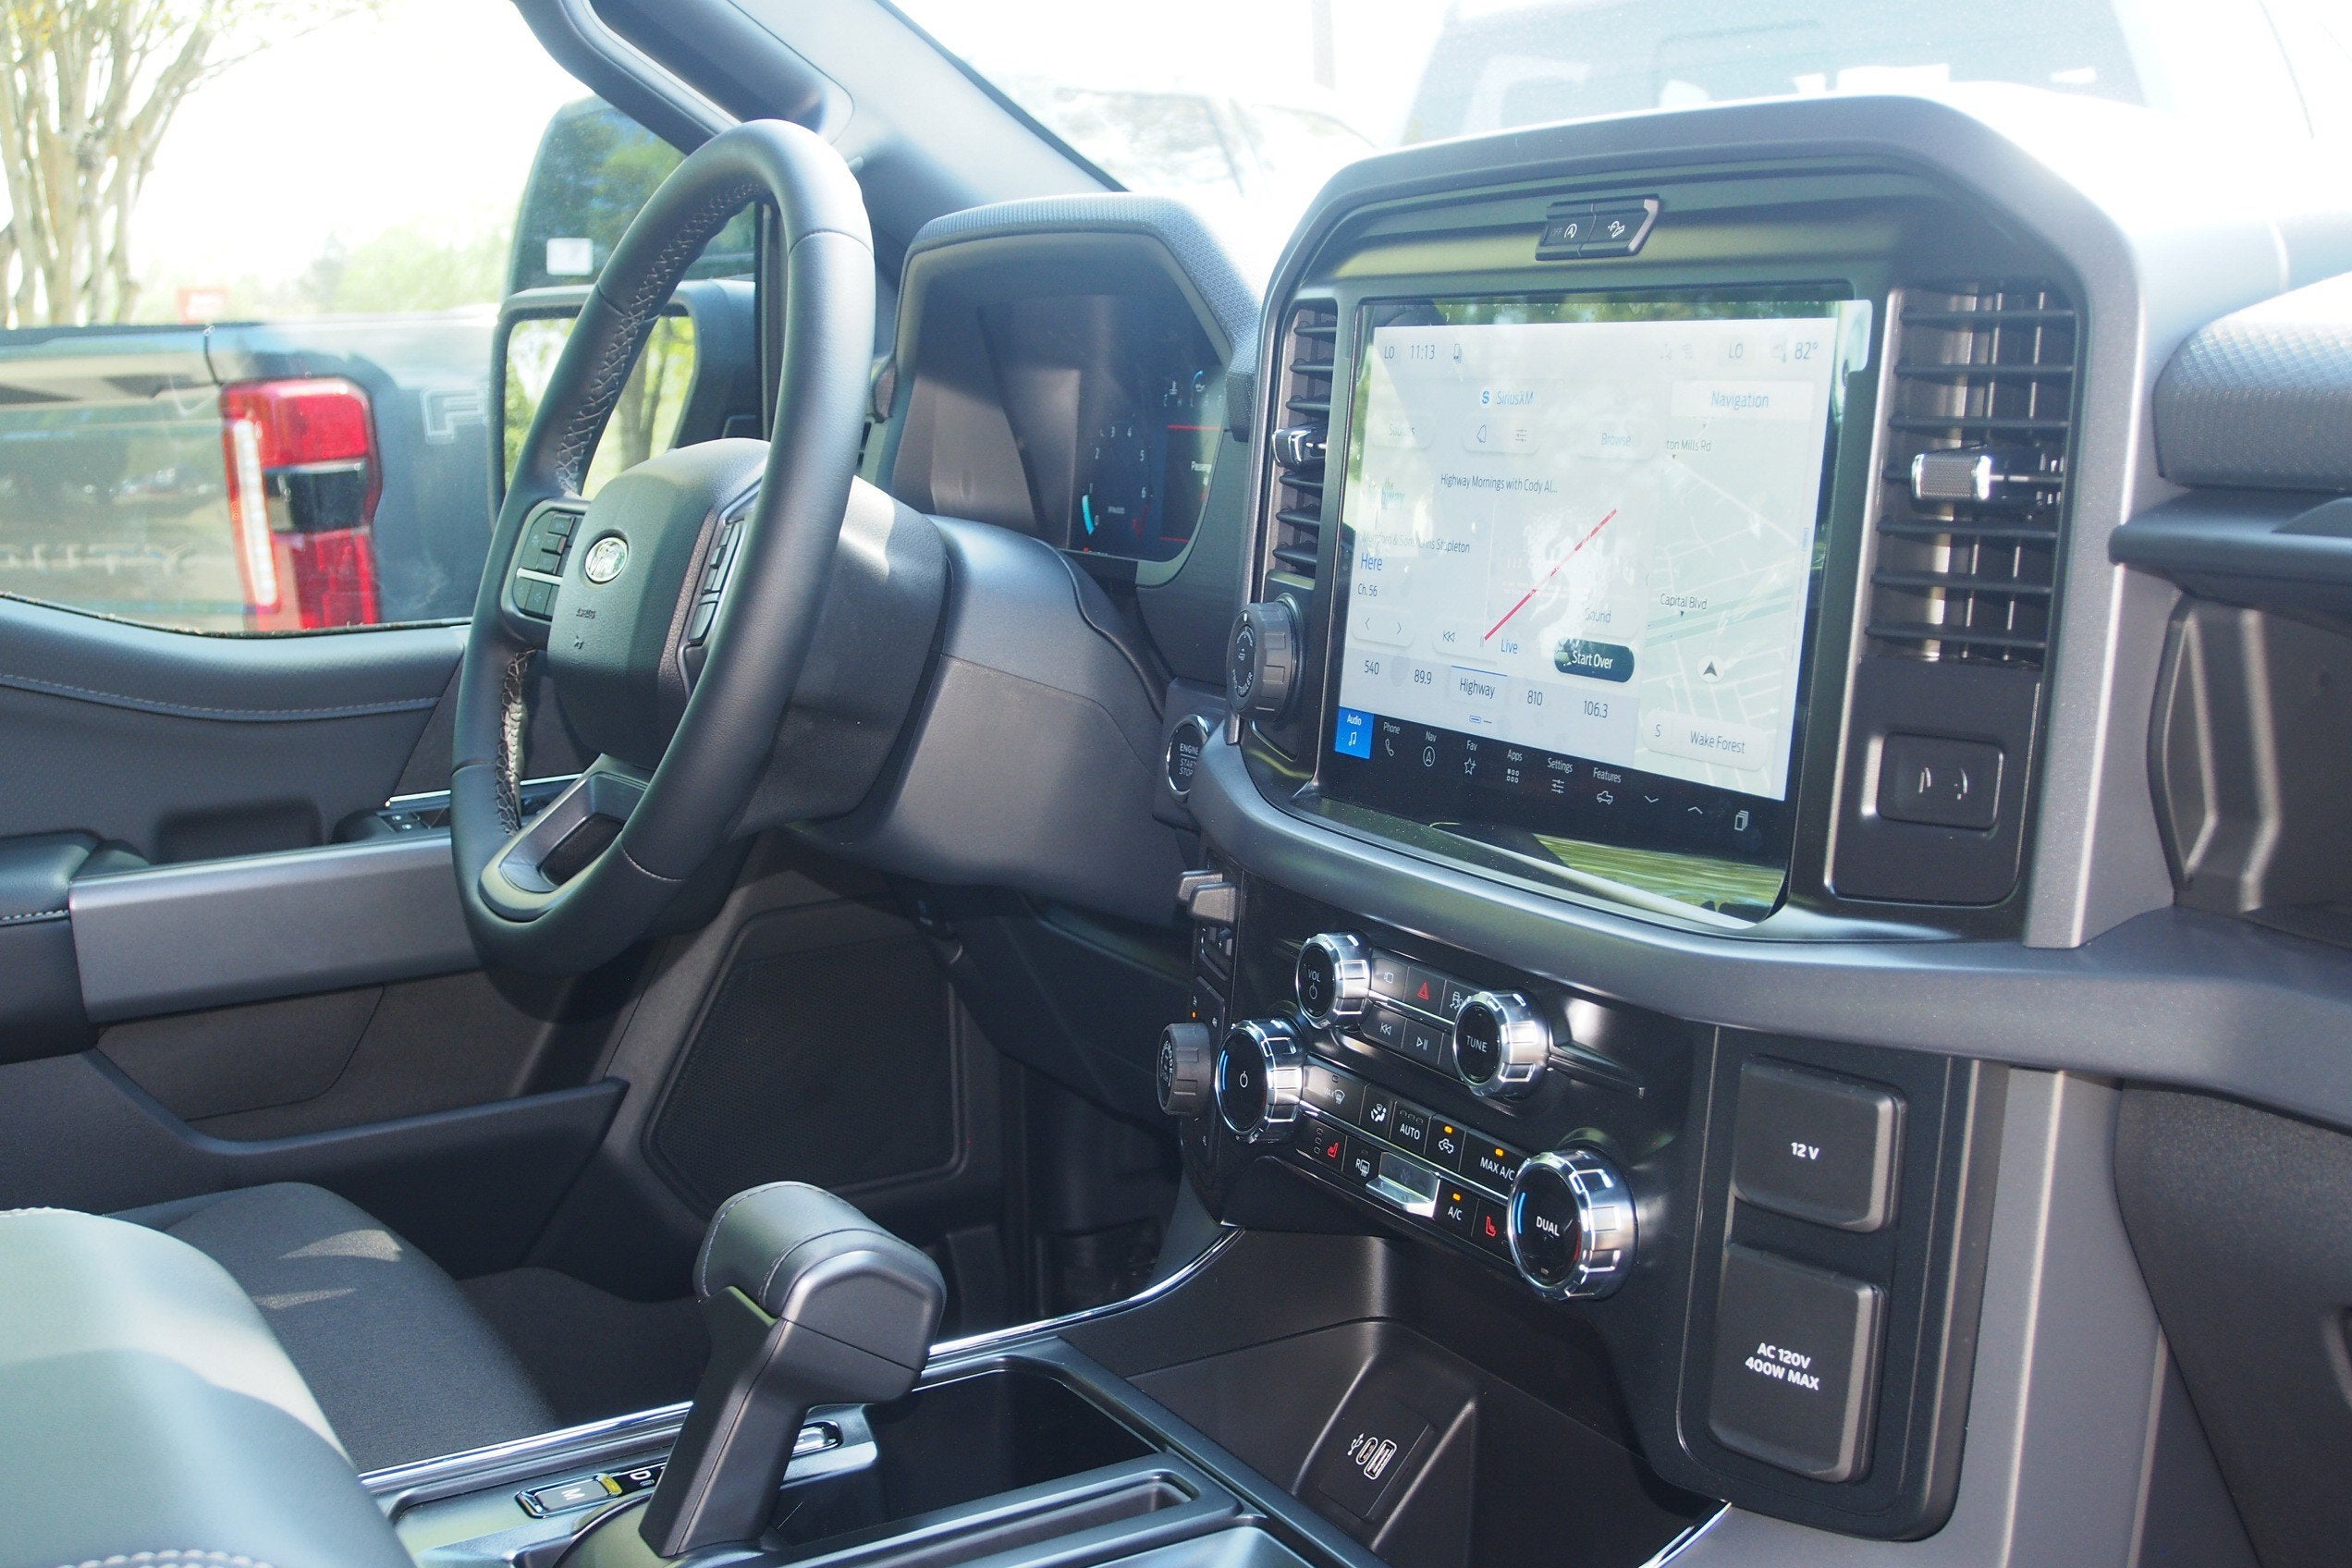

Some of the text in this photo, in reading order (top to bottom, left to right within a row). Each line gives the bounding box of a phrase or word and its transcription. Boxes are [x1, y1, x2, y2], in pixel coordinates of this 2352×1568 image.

[1384, 344, 1435, 360] LO 11:13
[1728, 343, 1744, 359] LO
[1496, 390, 1534, 406] SiriusXM
[1711, 390, 1769, 410] Navigation
[1389, 423, 1415, 436] Sous
[1600, 433, 1631, 447] Browse
[1681, 439, 1699, 451] Mills
[1700, 440, 1711, 452] Rd
[1440, 473, 1471, 488] Highway
[1472, 475, 1504, 491] Mornings
[1505, 477, 1523, 490] with
[1524, 479, 1543, 493] Cody
[1360, 555, 1383, 571] Here
[1357, 582, 1378, 596] Ch. 56
[1660, 593, 1708, 610] Capital Blvd
[1585, 607, 1611, 623] Sound
[1501, 638, 1518, 655] Live
[1364, 660, 1379, 675] 540
[1572, 650, 1613, 669] Start Over
[1415, 669, 1432, 685] 89.9
[1460, 678, 1496, 699] Highway
[1527, 690, 1543, 705] 810
[1584, 700, 1608, 718] 106.3
[1346, 714, 1362, 726] Audio
[1383, 721, 1401, 735] Phone
[1425, 730, 1438, 742] Nav
[1690, 730, 1746, 753] Wake Forest
[1179, 742, 1200, 755] ENGINE
[1466, 740, 1478, 752] Fav
[1507, 749, 1523, 762] Apps
[1548, 757, 1574, 773] Settings
[1593, 766, 1622, 783] Features
[1307, 969, 1320, 983] VOL
[1466, 1035, 1488, 1053] TUNE
[1399, 1122, 1421, 1141] AUTO
[1480, 1157, 1515, 1182] MAX A/C
[1447, 1206, 1463, 1221] A/C
[1536, 1215, 1561, 1238] DUAL
[1757, 1341, 1811, 1370] AC 120V
[1745, 1355, 1820, 1390] 400W MAX
